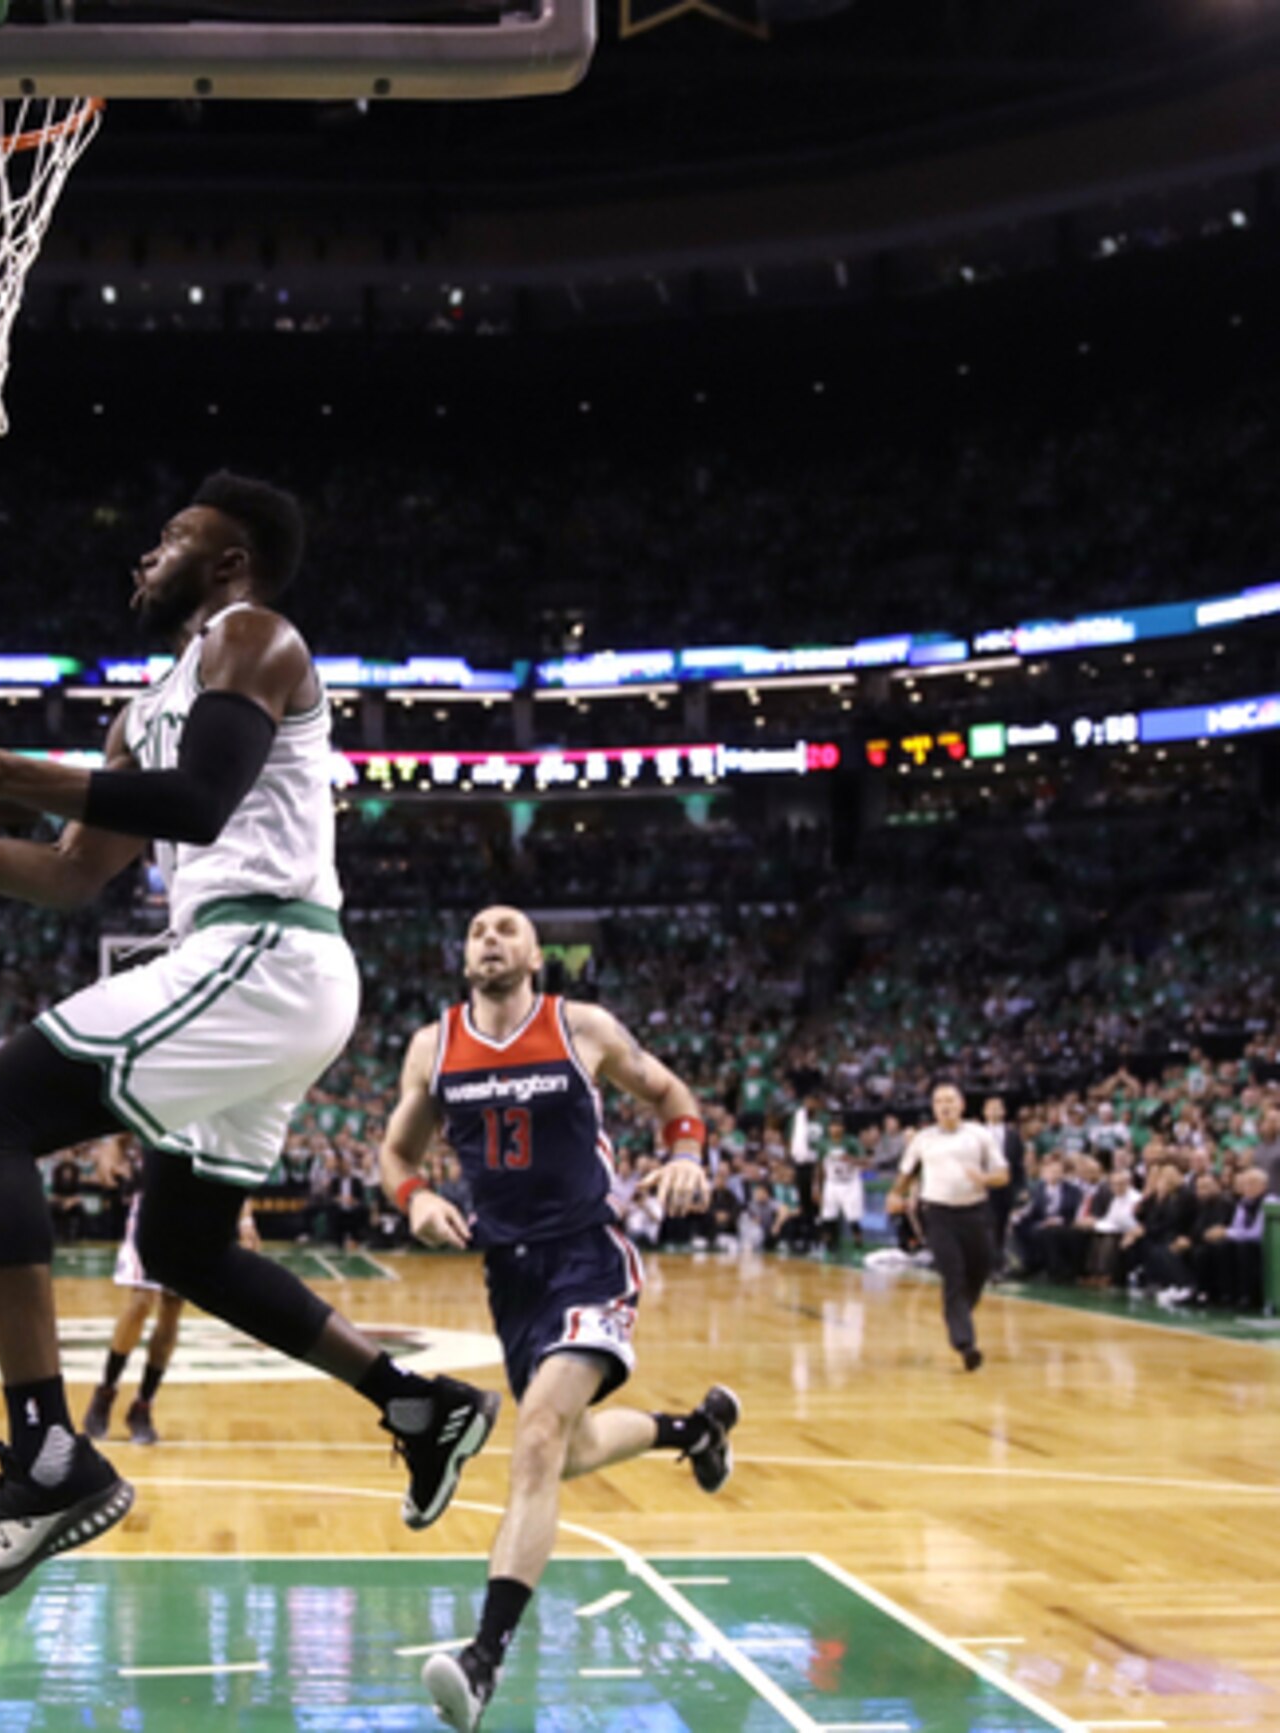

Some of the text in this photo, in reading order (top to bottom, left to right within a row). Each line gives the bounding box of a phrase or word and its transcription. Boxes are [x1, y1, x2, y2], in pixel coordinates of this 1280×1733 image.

[1206, 702, 1258, 736] NBC
[444, 1073, 570, 1103] washington
[482, 1107, 532, 1170] 13
